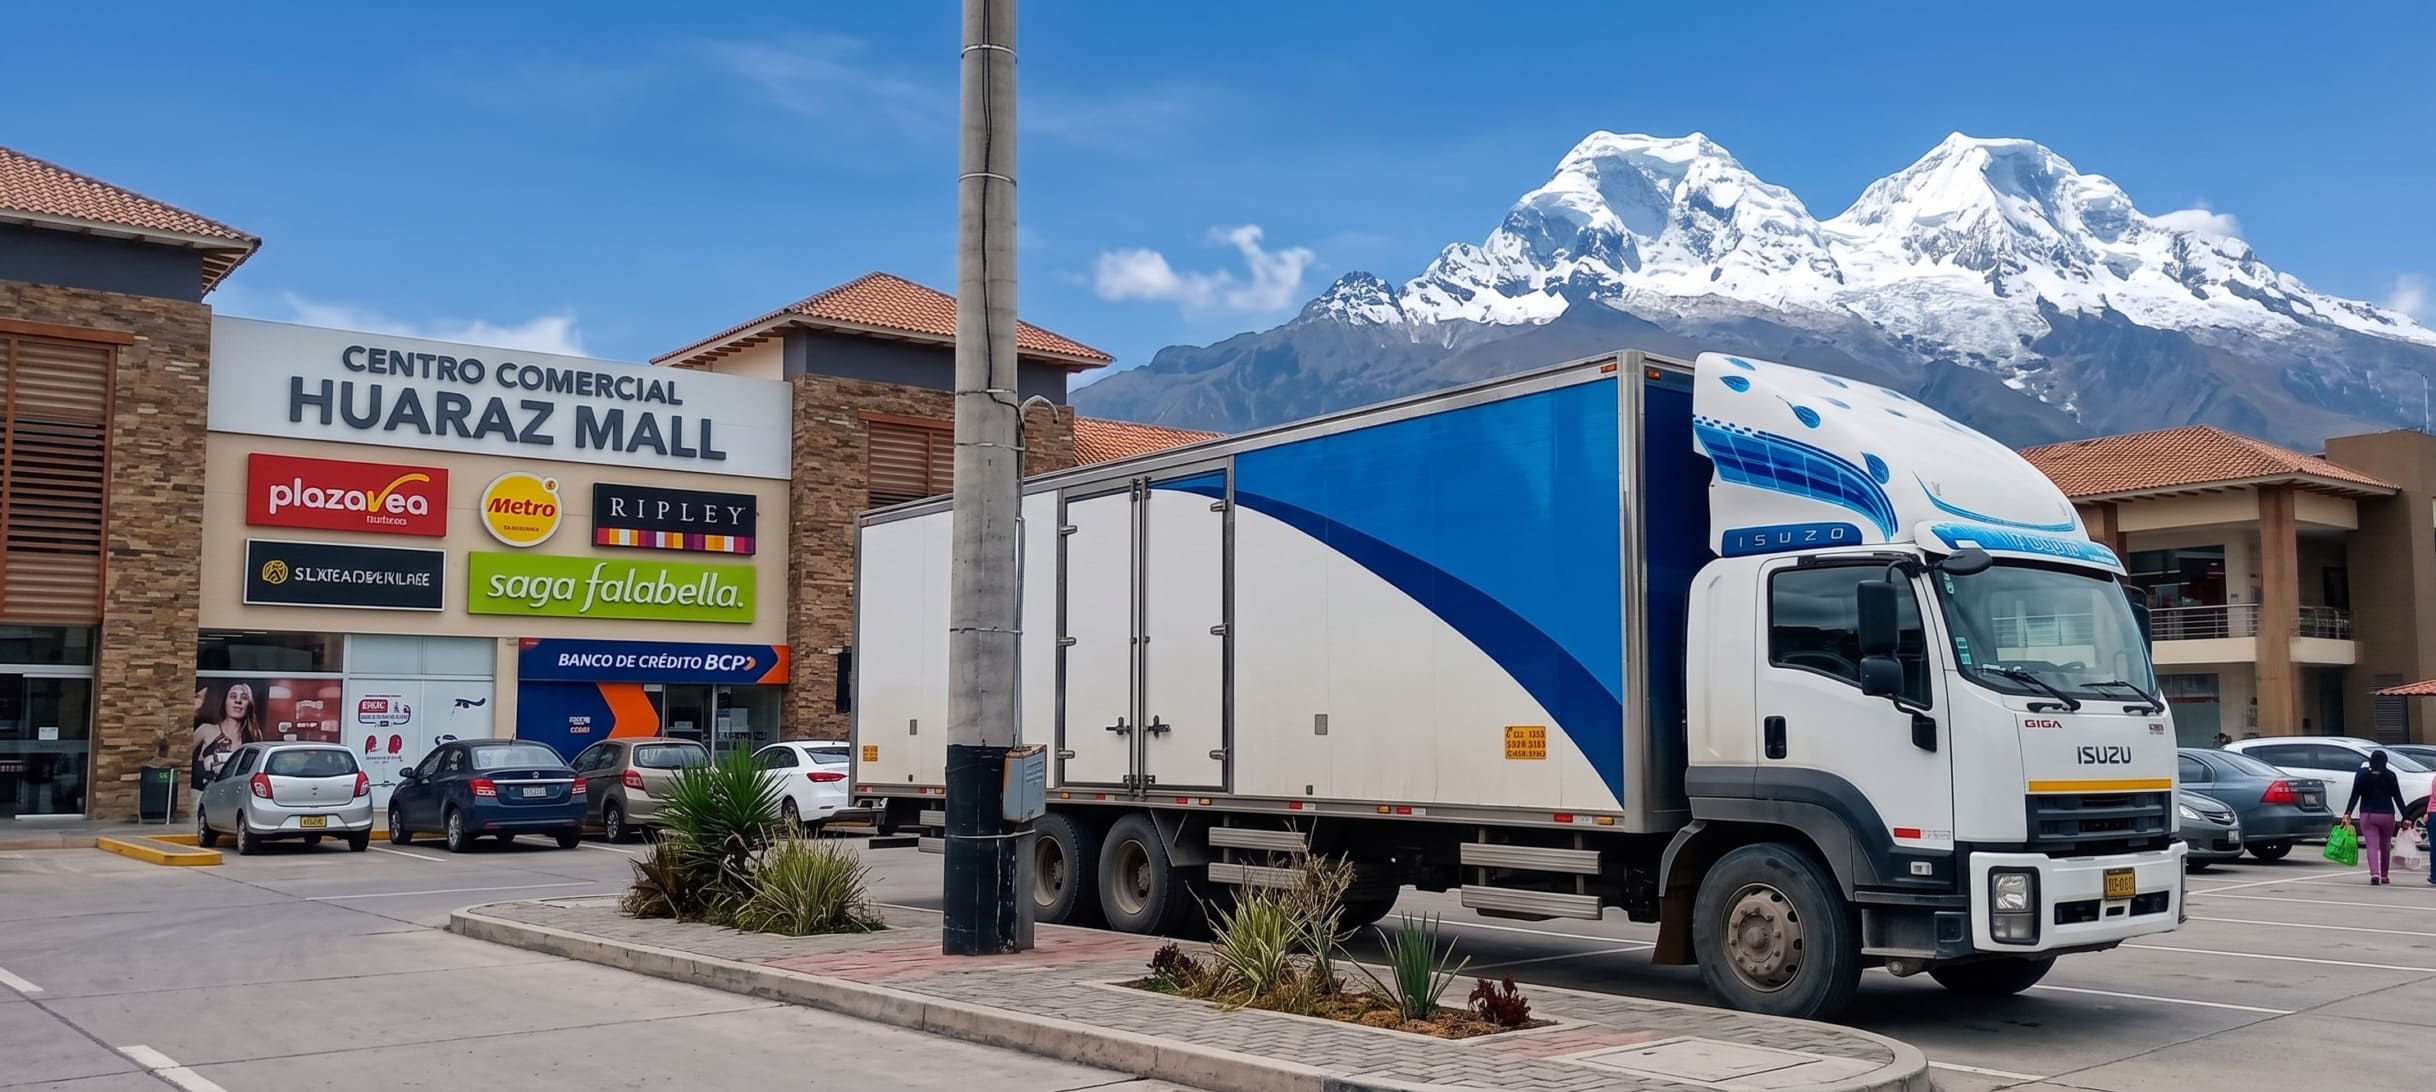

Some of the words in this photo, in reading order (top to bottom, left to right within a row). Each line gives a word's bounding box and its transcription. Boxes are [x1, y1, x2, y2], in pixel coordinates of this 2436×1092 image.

[342, 345, 486, 385] CENTRO
[496, 362, 683, 406] COMERCIAL
[289, 376, 555, 446] HUARAZ
[575, 405, 727, 460] MALL
[487, 497, 556, 518] Metro
[610, 497, 746, 525] RIPLEY
[487, 574, 576, 609] saga
[558, 653, 612, 668] BANCO
[616, 655, 636, 669] DE
[638, 651, 703, 670] CRÉDITO
[704, 654, 746, 671] BCP
[2024, 719, 2063, 729] GIGA
[2077, 746, 2132, 765] ISUZU
